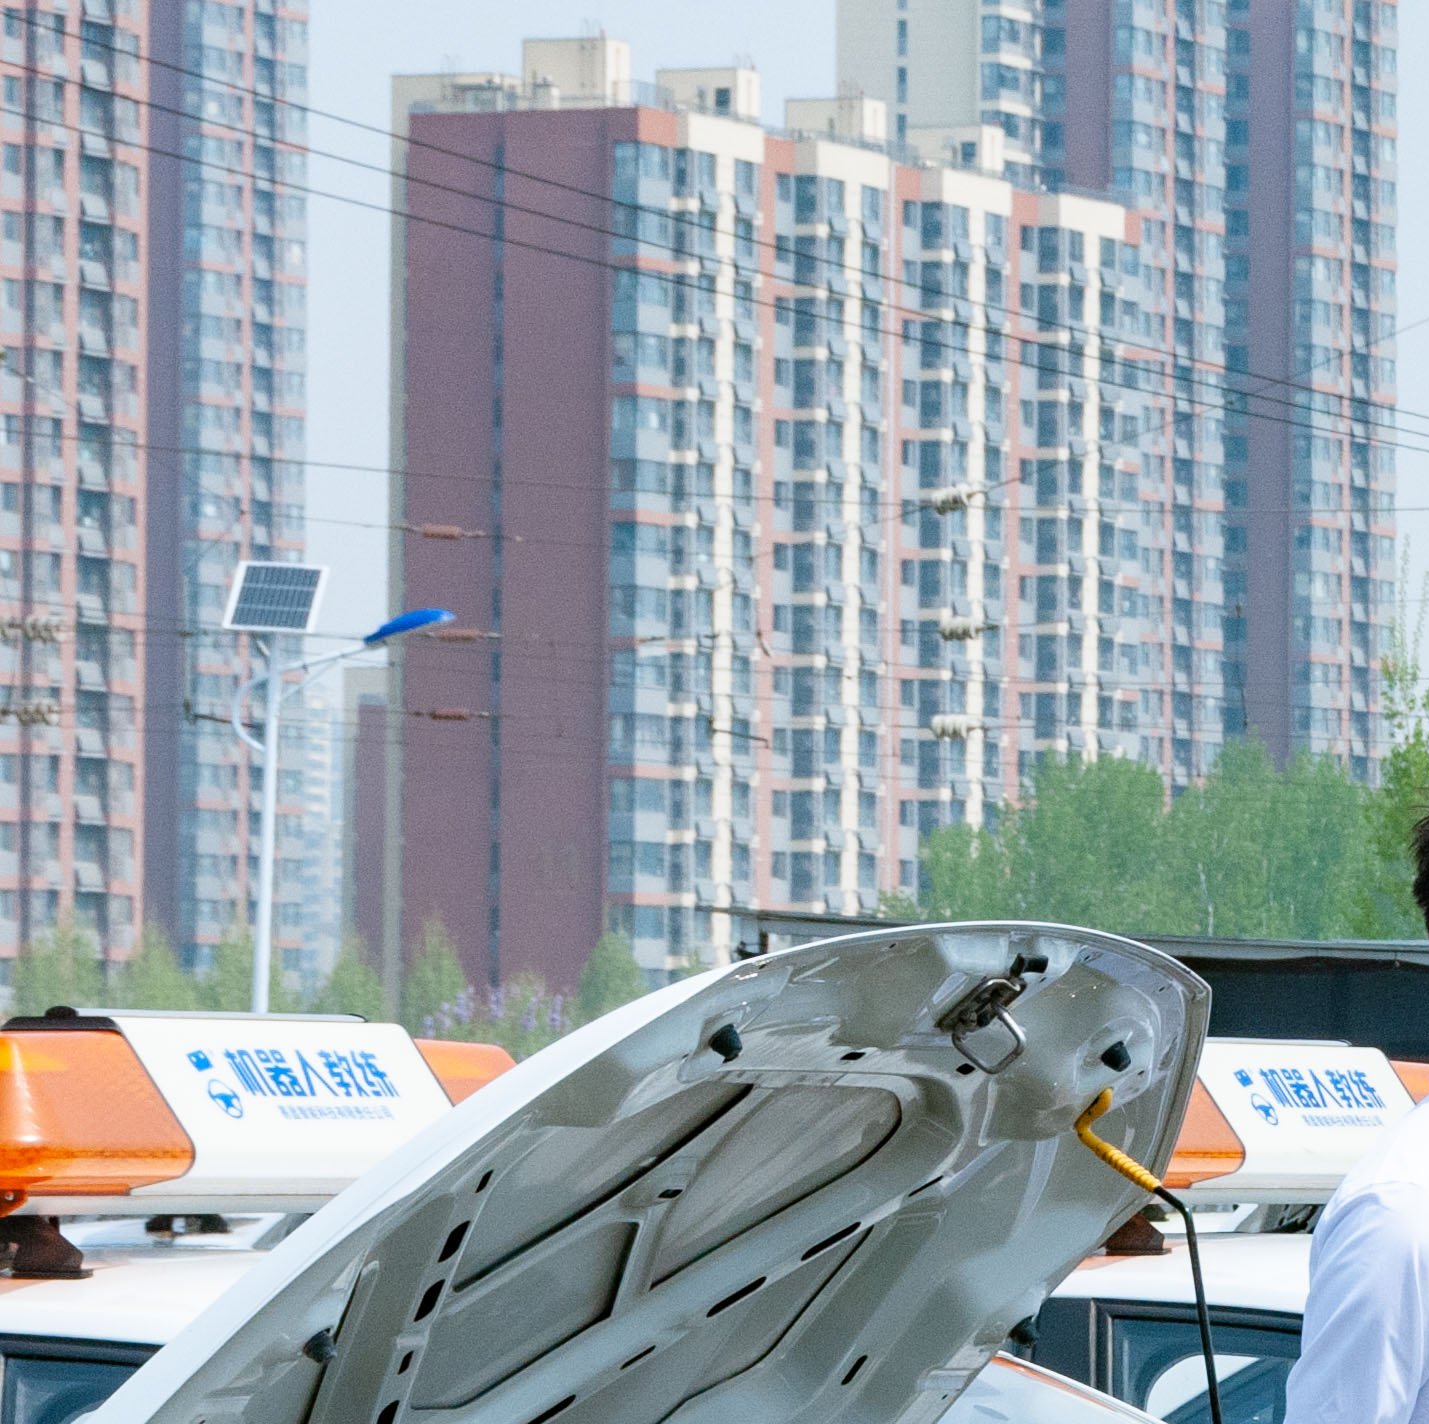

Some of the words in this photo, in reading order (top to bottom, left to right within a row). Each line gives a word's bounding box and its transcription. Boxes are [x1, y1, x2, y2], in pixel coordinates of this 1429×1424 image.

[223, 1048, 400, 1097] 机器人教练
[1259, 1068, 1387, 1109] 机器人教练
